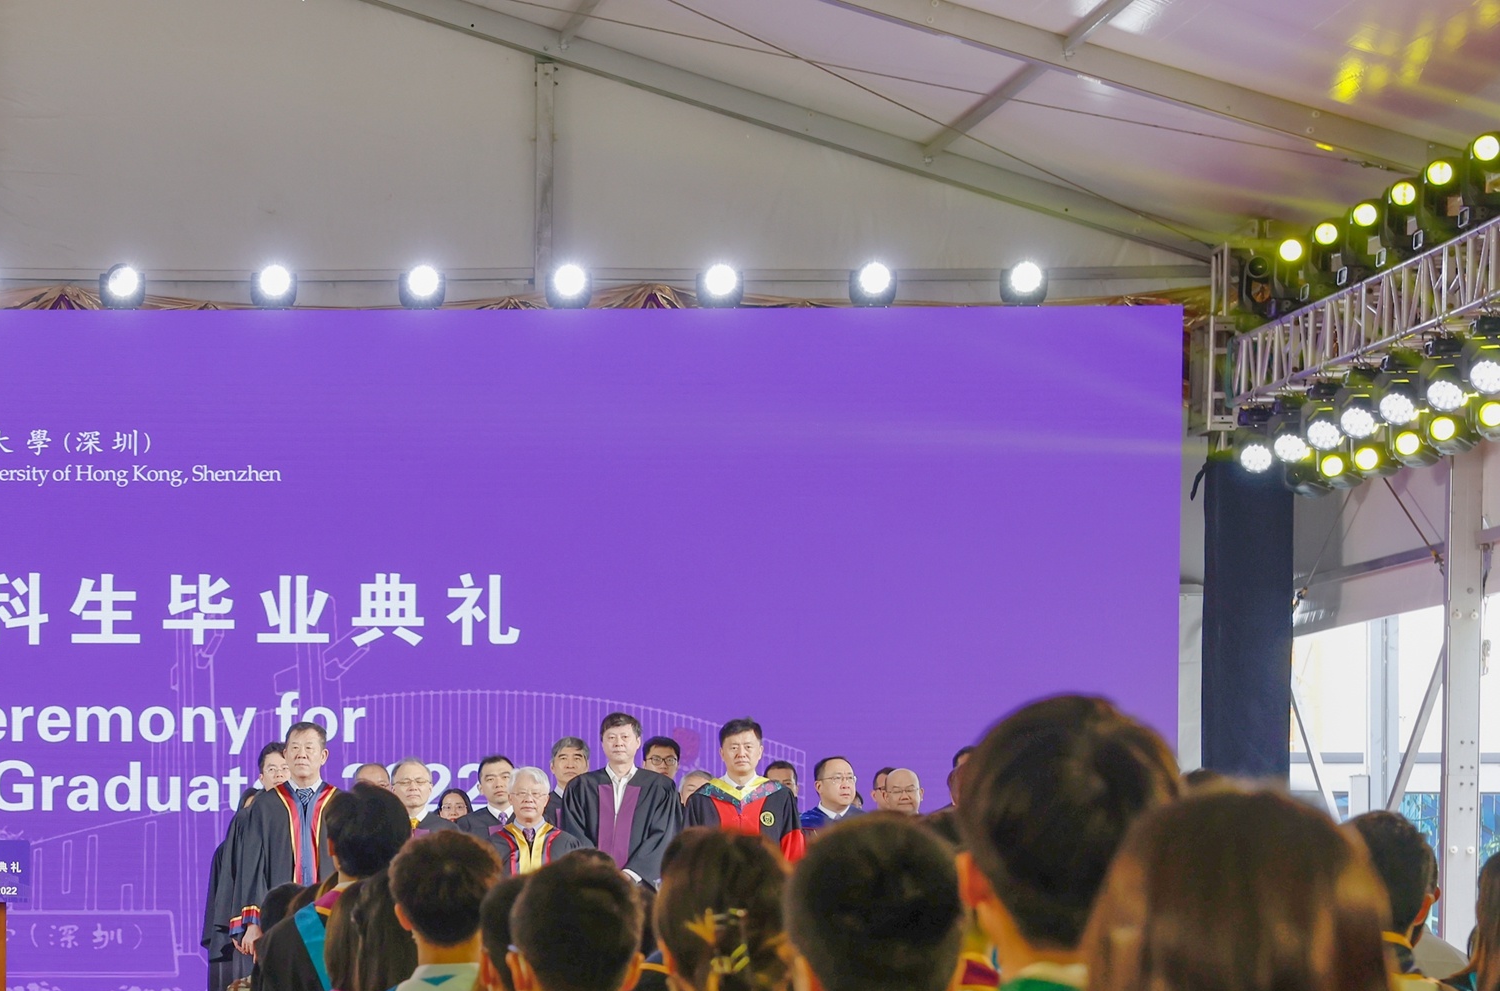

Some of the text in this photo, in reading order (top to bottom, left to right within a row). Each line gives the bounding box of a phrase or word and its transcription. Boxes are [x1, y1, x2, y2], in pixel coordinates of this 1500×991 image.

[52, 463, 73, 481] of
[76, 464, 129, 487] Hong
[132, 464, 189, 488] Kong,
[192, 464, 282, 482] Shenzhen
[275, 691, 366, 742] for
